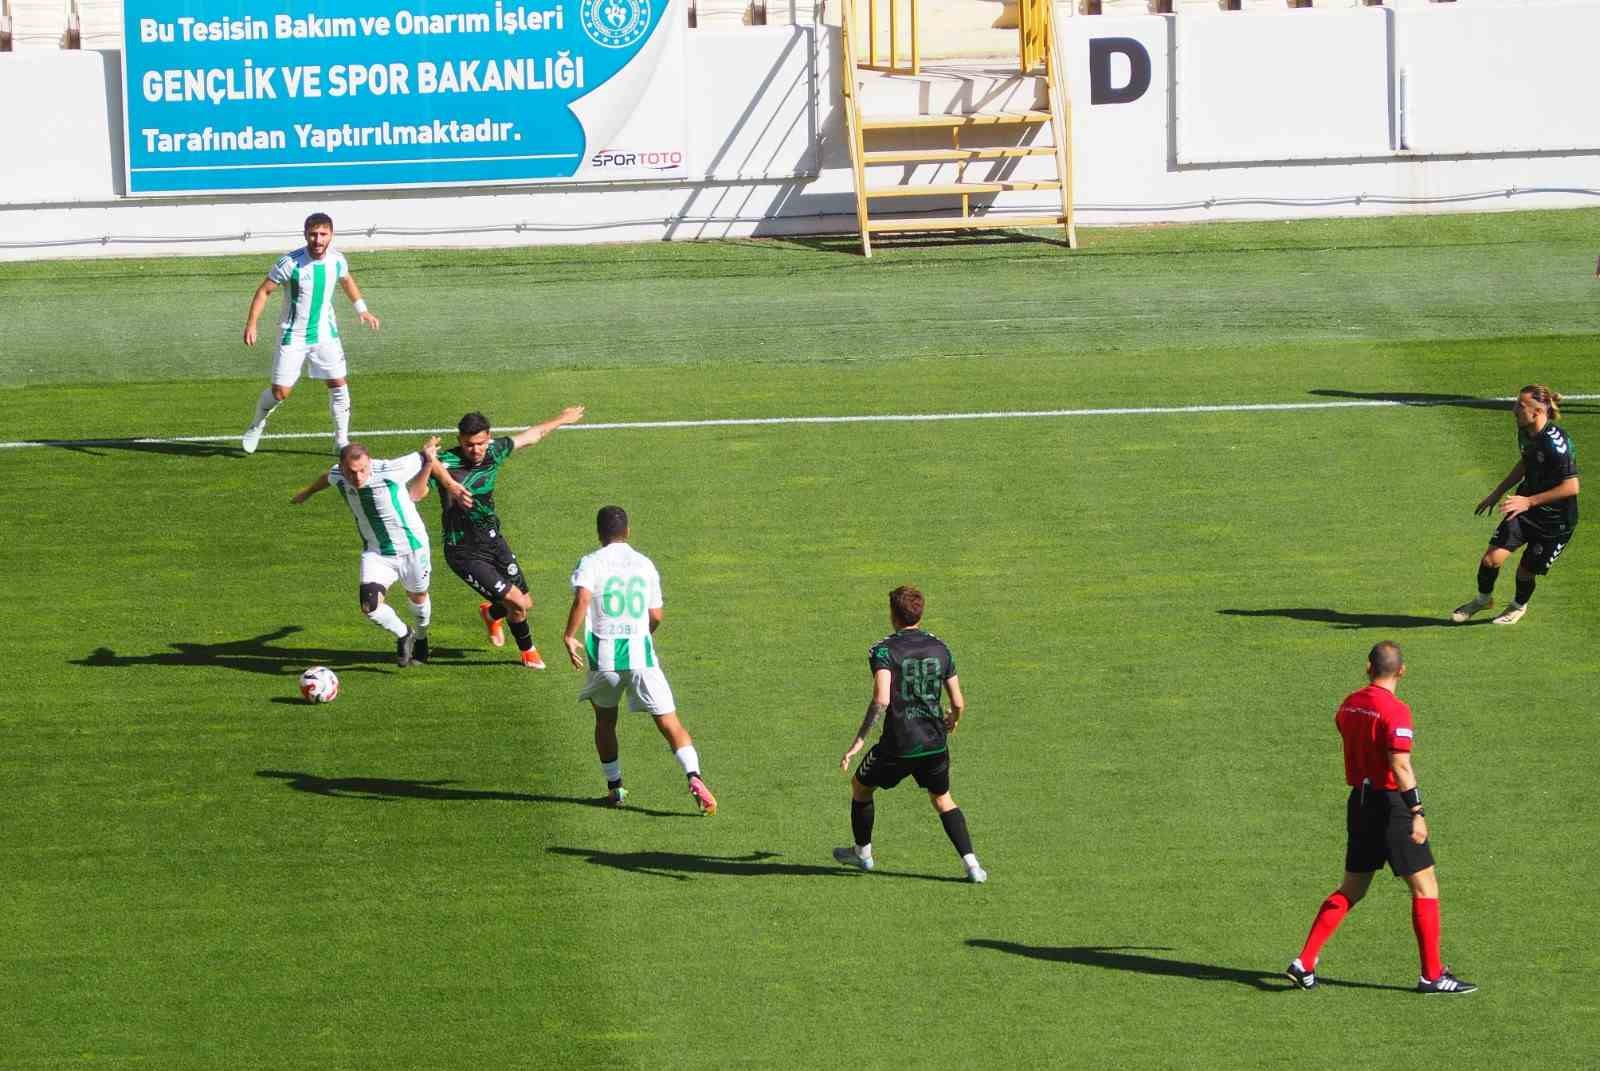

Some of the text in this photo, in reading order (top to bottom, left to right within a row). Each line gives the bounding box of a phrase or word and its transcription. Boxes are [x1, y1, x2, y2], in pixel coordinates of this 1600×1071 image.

[140, 18, 175, 43] Bu
[177, 16, 269, 42] Tesisin
[275, 13, 357, 39] Bakım
[359, 16, 391, 36] ve
[395, 10, 490, 35] Onarım
[495, 1, 563, 35] İşleri
[143, 50, 584, 105] GENÇLİK VE SPOR BAKANLIĞI
[1089, 37, 1152, 105] D
[141, 117, 522, 153] Tarafından Yaptırılmaktadır.
[603, 575, 646, 619] 66
[901, 657, 941, 701] 88
